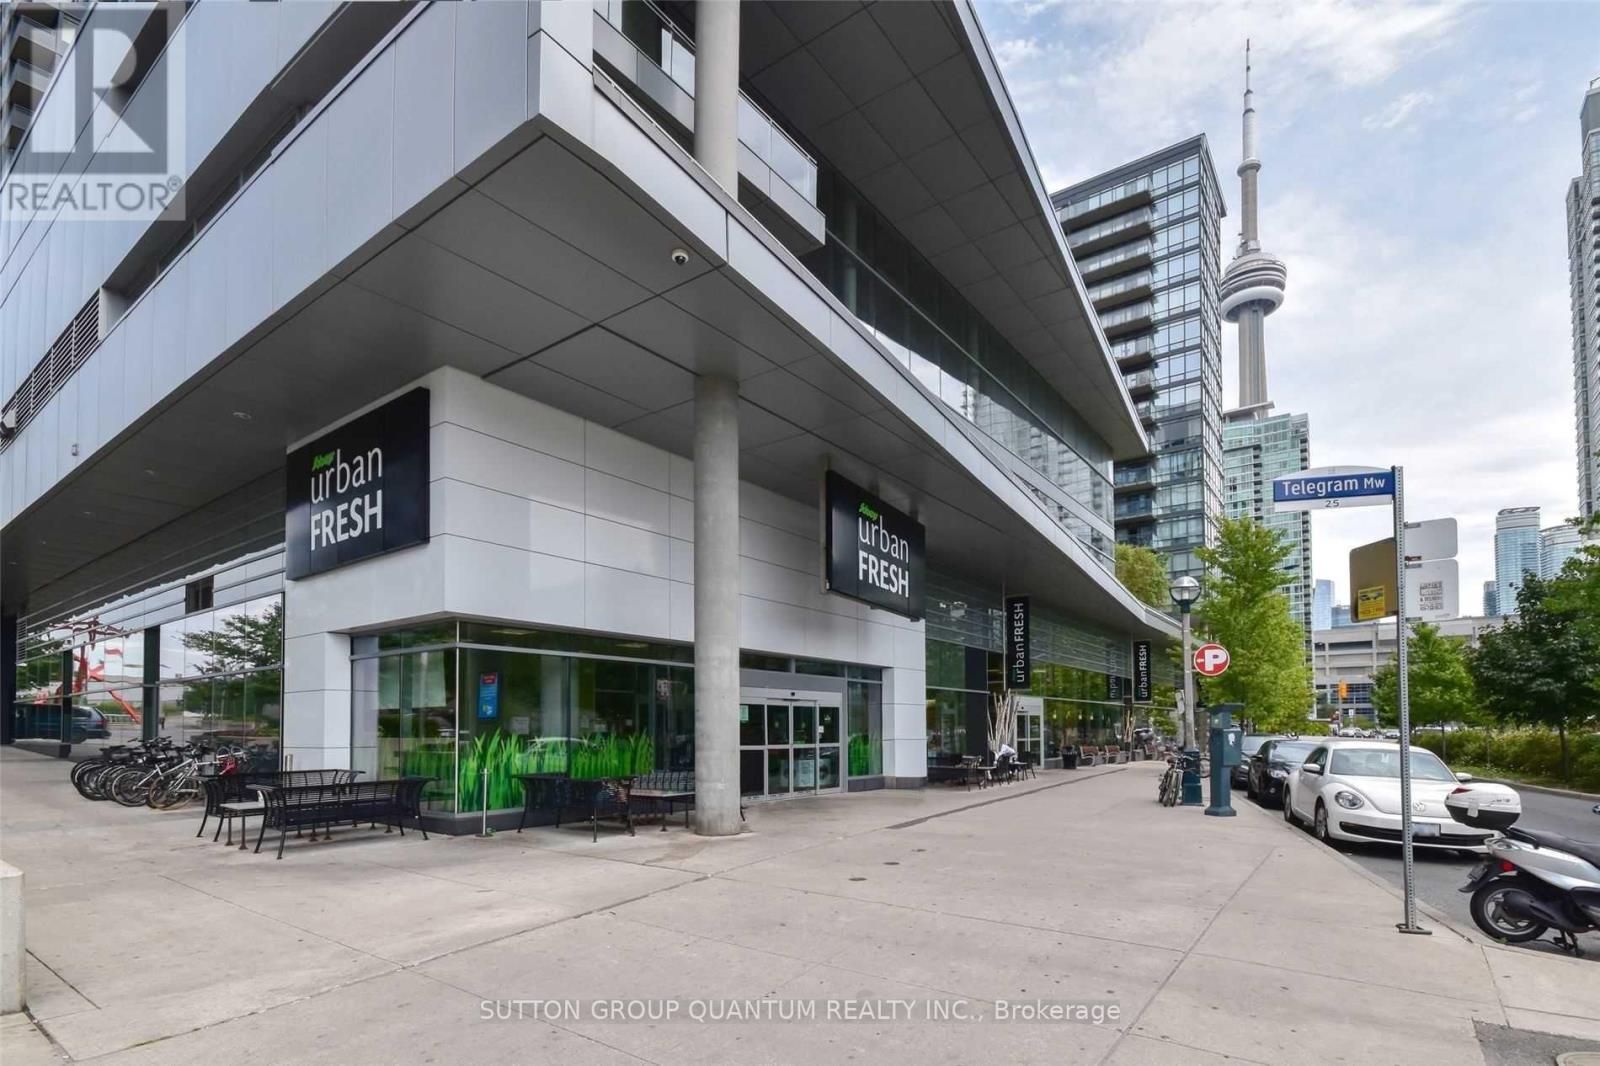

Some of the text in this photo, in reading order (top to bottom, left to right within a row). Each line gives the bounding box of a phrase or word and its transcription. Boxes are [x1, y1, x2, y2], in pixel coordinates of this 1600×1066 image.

[311, 447, 382, 504] urban
[1282, 477, 1386, 497] Telegram Mw
[311, 489, 382, 551] FRESH
[1325, 499, 1340, 508] 25
[858, 514, 909, 563] urban
[858, 550, 909, 598] FRESH
[1204, 649, 1227, 671] P
